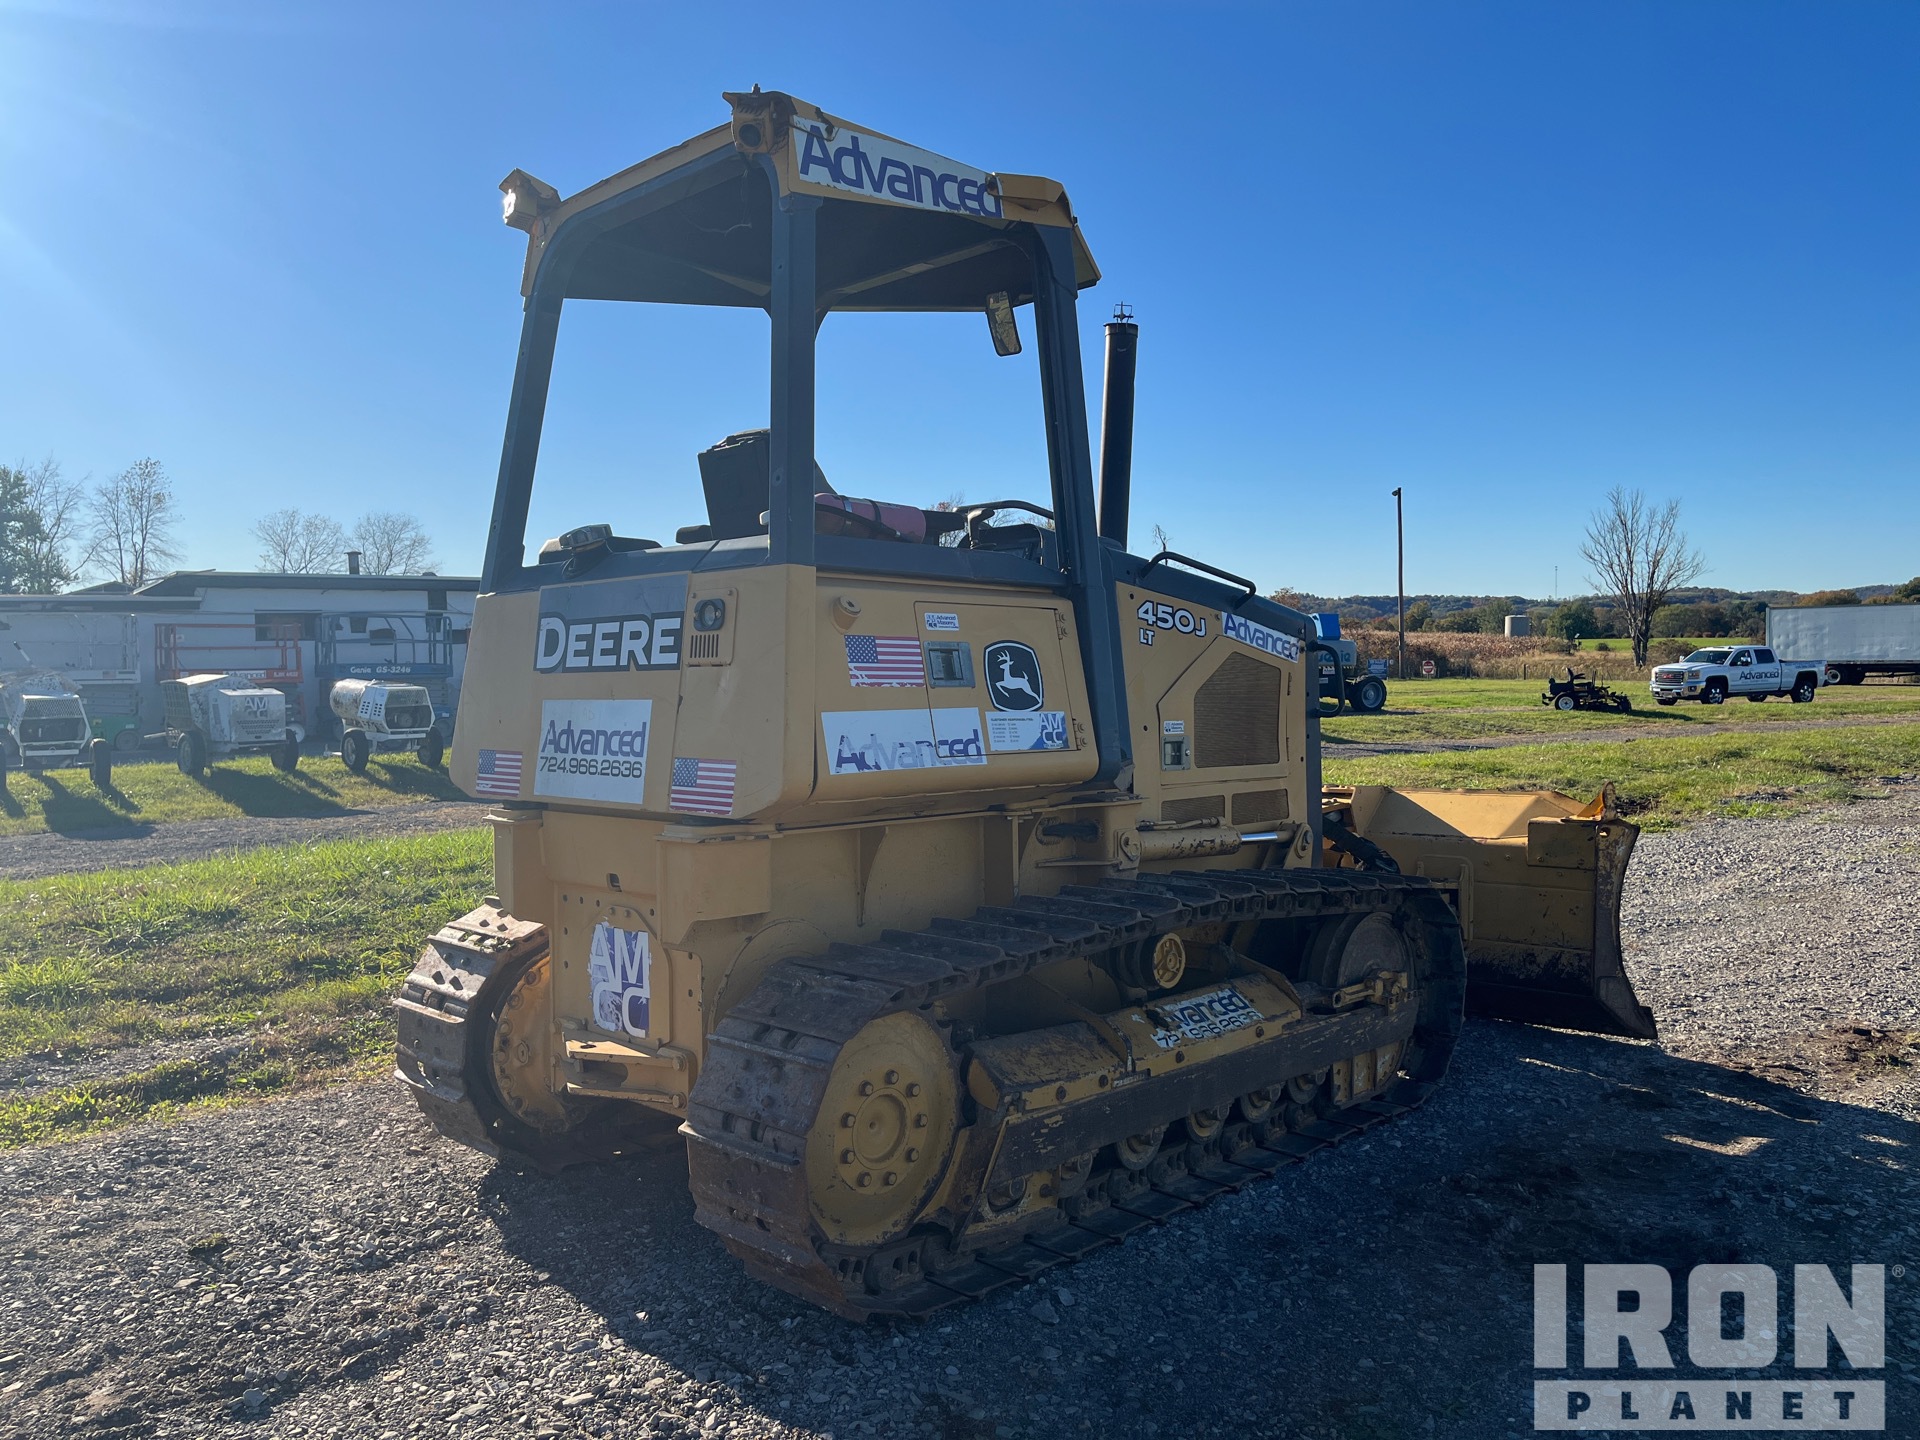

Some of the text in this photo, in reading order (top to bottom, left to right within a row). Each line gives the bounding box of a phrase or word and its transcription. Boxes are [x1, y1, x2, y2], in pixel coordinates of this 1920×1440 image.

[1137, 600, 1206, 637] 450J
[536, 617, 681, 669] DEERE
[1139, 628, 1155, 646] LT
[350, 666, 371, 674] Genie
[1739, 668, 1779, 680] Advanced
[541, 719, 647, 757] Advanced
[835, 729, 983, 773] Advanced
[539, 755, 643, 779] 724.966.2636
